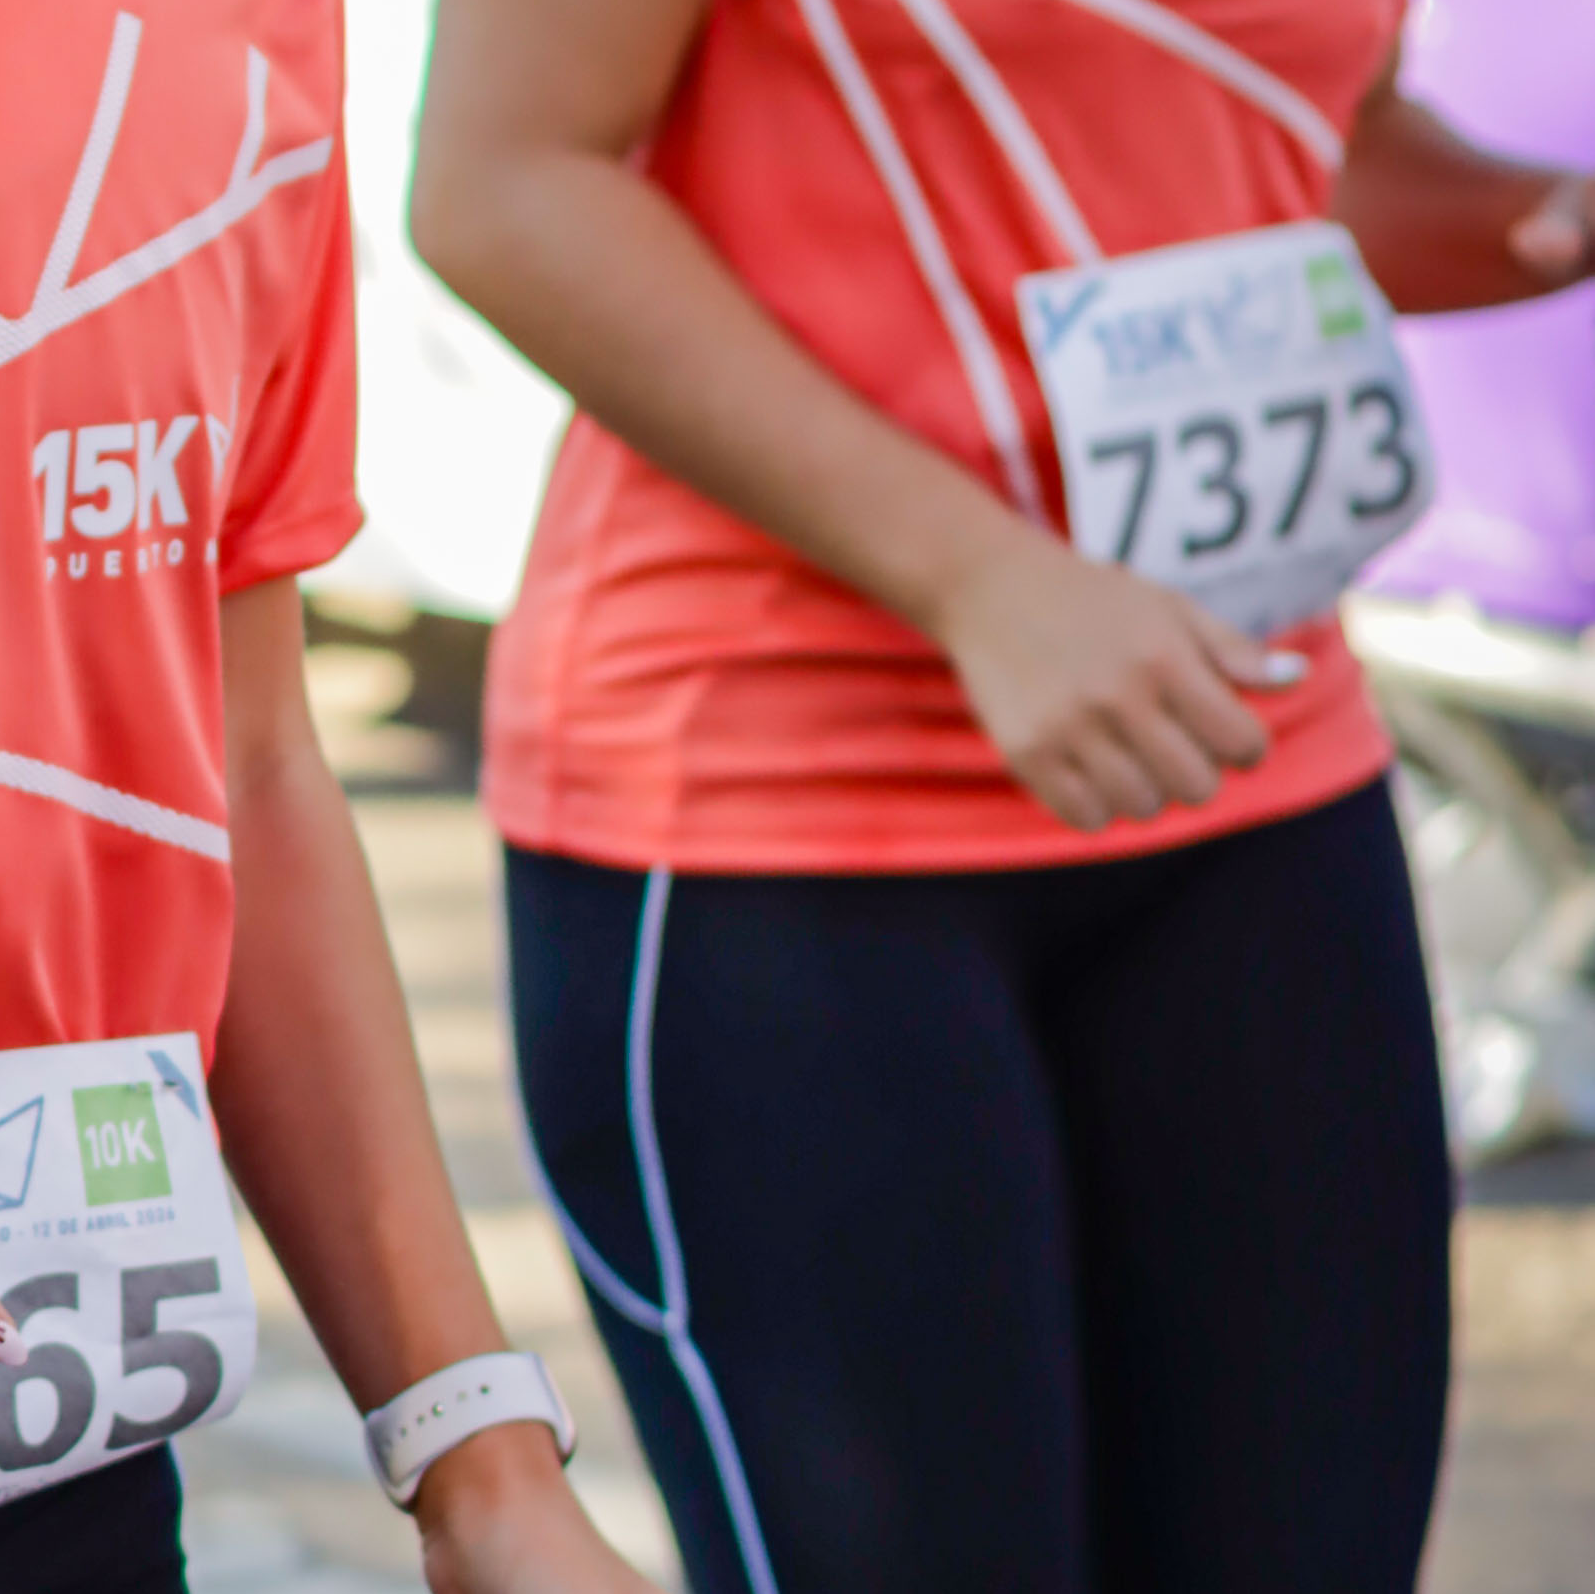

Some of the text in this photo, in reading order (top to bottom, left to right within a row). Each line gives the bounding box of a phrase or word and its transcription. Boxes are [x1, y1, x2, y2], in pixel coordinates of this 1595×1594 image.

[32, 414, 200, 542] 15K
[1088, 380, 1417, 565] 7373
[85, 1118, 156, 1170] 10K
